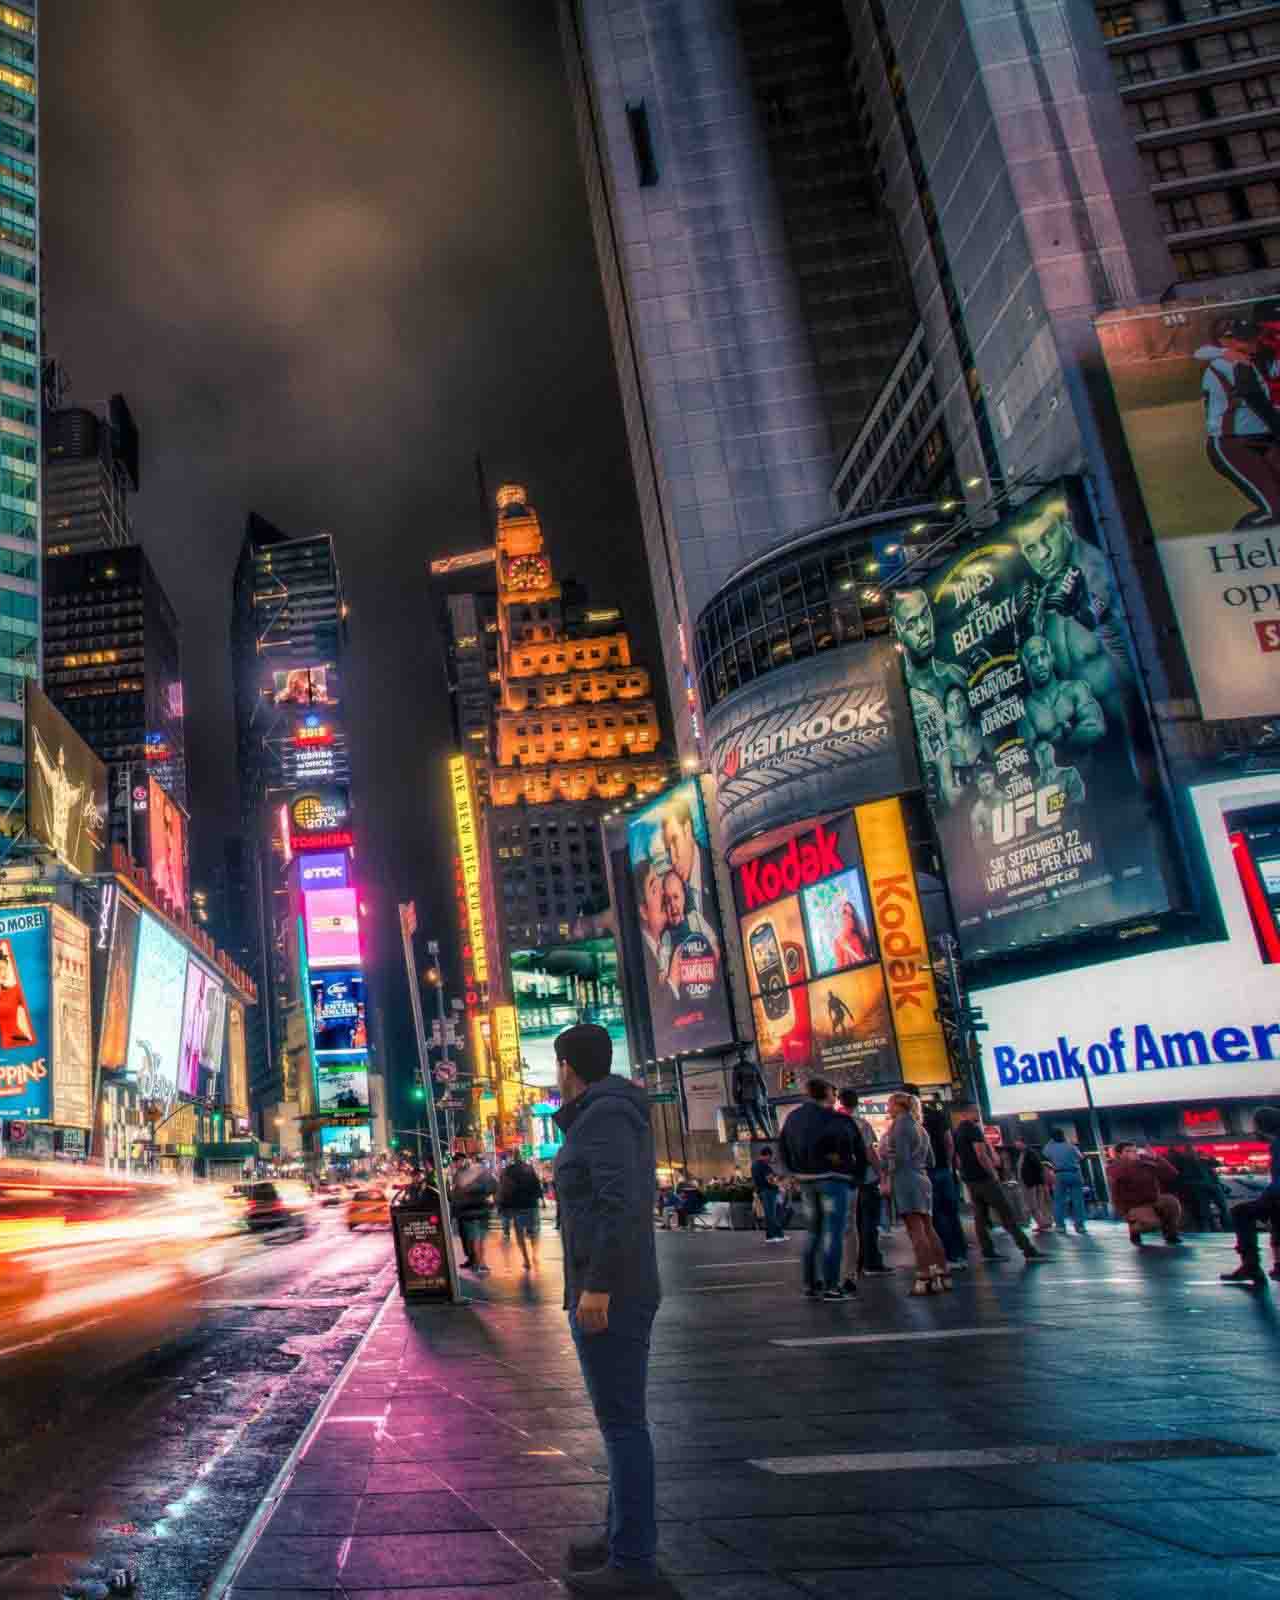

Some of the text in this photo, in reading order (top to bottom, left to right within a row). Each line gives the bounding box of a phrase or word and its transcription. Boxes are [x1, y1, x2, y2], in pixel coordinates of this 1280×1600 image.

[1207, 537, 1280, 574] Hel
[952, 572, 994, 608] JONES
[952, 599, 1013, 656] BELFORT
[968, 663, 1024, 707] BENAVIDEZ
[981, 699, 1025, 737] JOHNSON
[806, 725, 888, 752] emotion
[458, 801, 472, 833] NEW
[992, 785, 1062, 845] UFC
[739, 822, 843, 909] Kodak
[1008, 836, 1066, 865] SEPTEMBER
[1065, 829, 1081, 848] 22
[311, 866, 343, 879] TDK
[984, 872, 1007, 892] LIVE
[1007, 867, 1021, 885] ON
[1021, 843, 1093, 881] PAY-PER-VIEW
[7, 912, 44, 930] MORE!
[872, 874, 929, 1010] Kodak
[993, 1036, 1085, 1086] Bank
[1087, 1027, 1127, 1074] of
